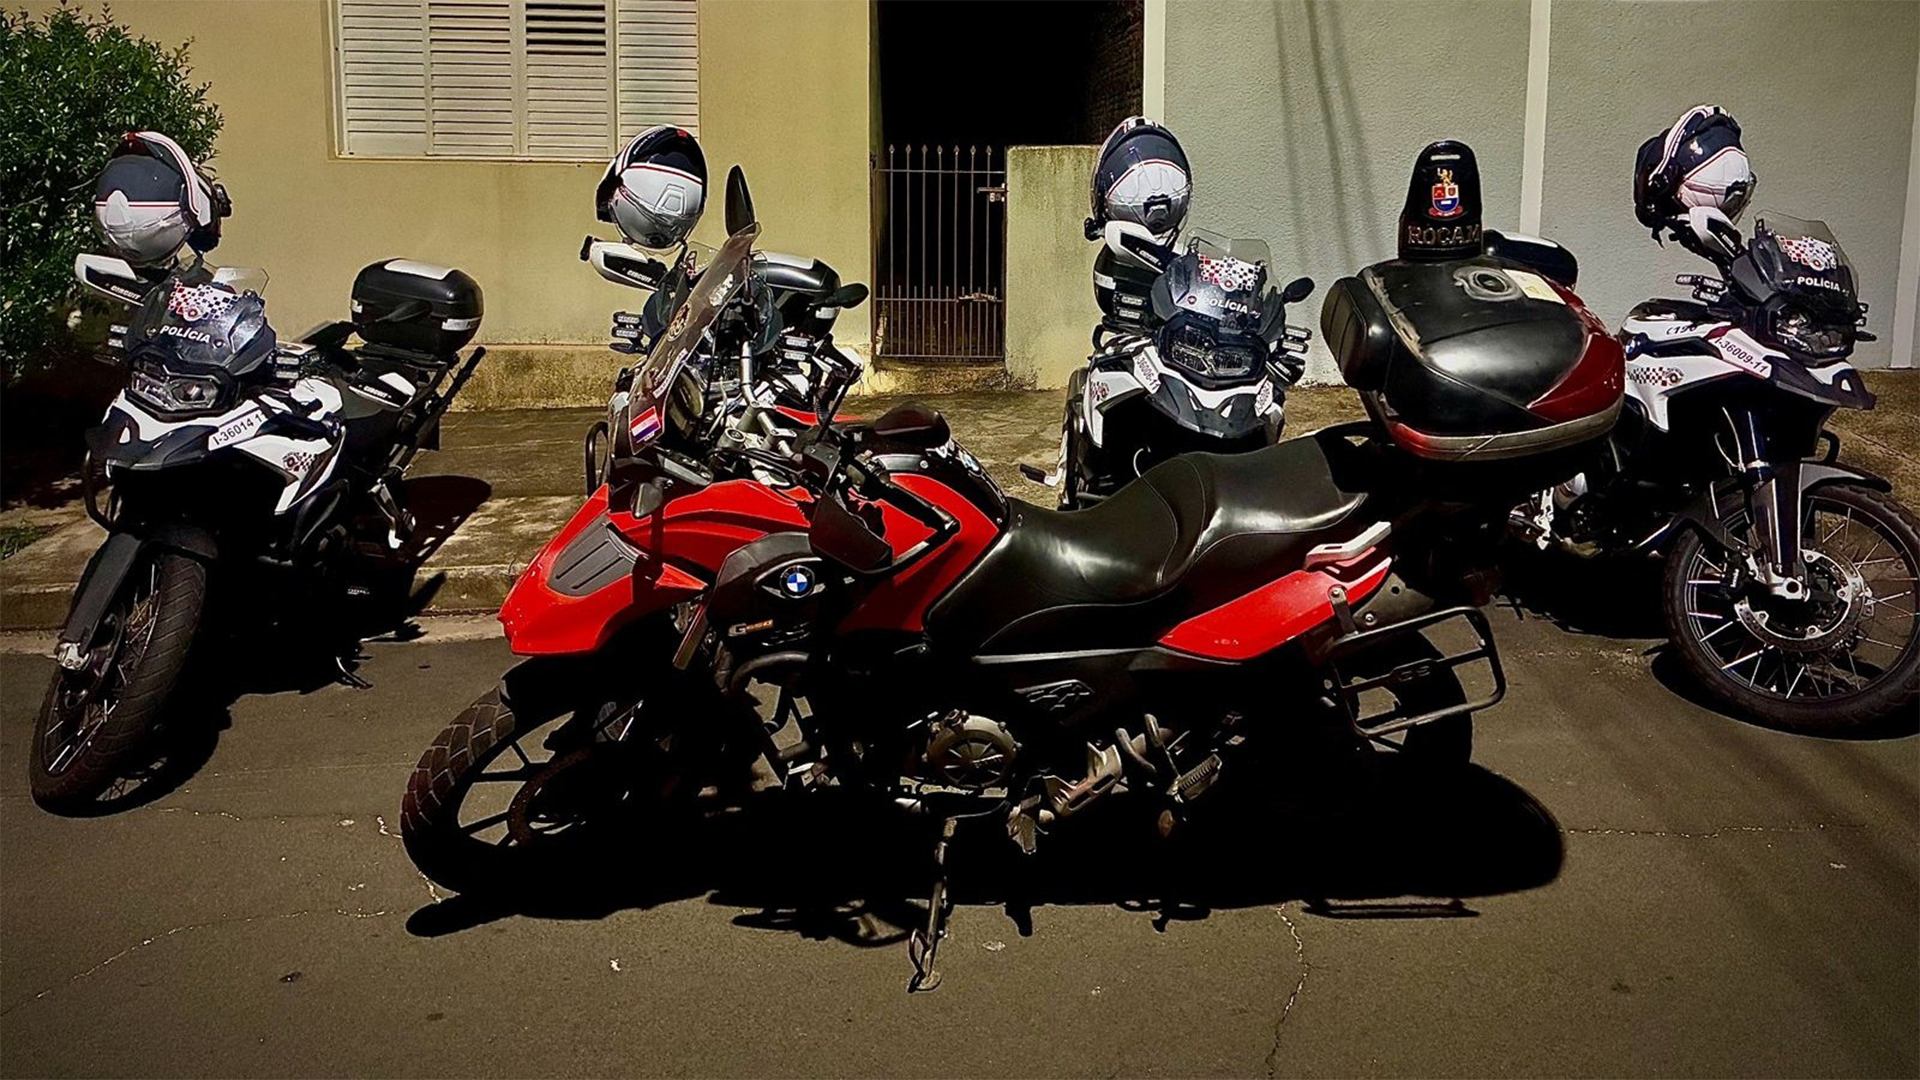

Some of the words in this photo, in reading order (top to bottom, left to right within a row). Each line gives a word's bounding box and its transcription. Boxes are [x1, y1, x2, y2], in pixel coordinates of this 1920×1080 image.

[1407, 223, 1481, 246] ROCAM
[110, 284, 142, 300] CIRCUIT
[1797, 276, 1841, 292] POLÍCIA
[160, 324, 211, 344] POLÍCIA
[1714, 337, 1769, 373] I-36009-11
[212, 417, 254, 446] I-36014
